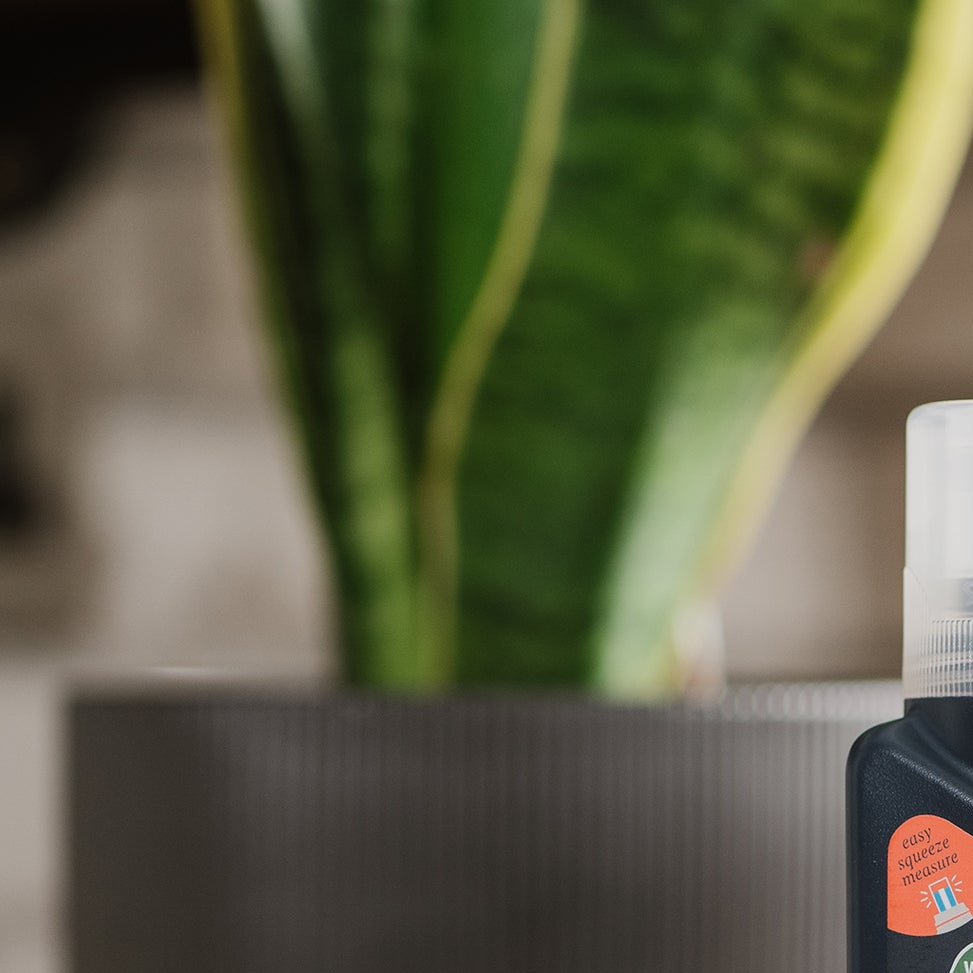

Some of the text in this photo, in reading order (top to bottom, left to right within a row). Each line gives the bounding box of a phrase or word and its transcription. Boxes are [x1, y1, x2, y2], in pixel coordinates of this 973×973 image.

[898, 837, 950, 872] squeeze
[902, 827, 932, 850] easy
[902, 852, 959, 887] measure
